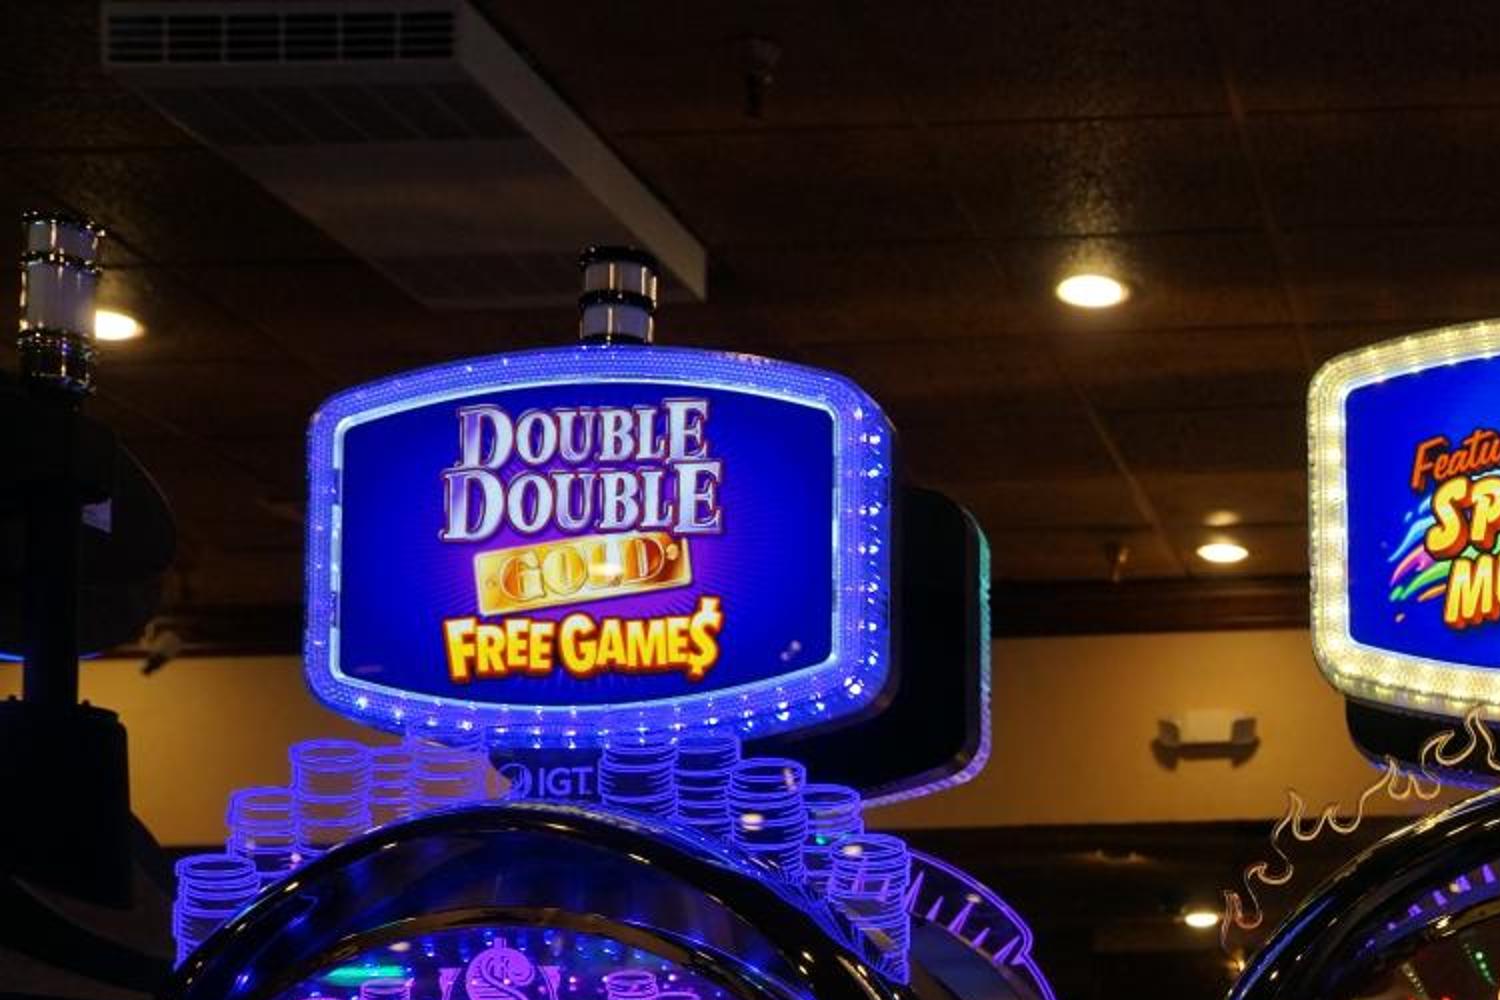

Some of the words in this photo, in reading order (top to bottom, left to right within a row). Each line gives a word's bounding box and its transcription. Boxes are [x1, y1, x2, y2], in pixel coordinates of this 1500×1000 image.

[455, 399, 709, 470] DOUBLE
[439, 461, 723, 541] DOUBLE
[500, 534, 667, 600] GOLD
[444, 614, 556, 681] FREE
[539, 767, 594, 795] IGT
